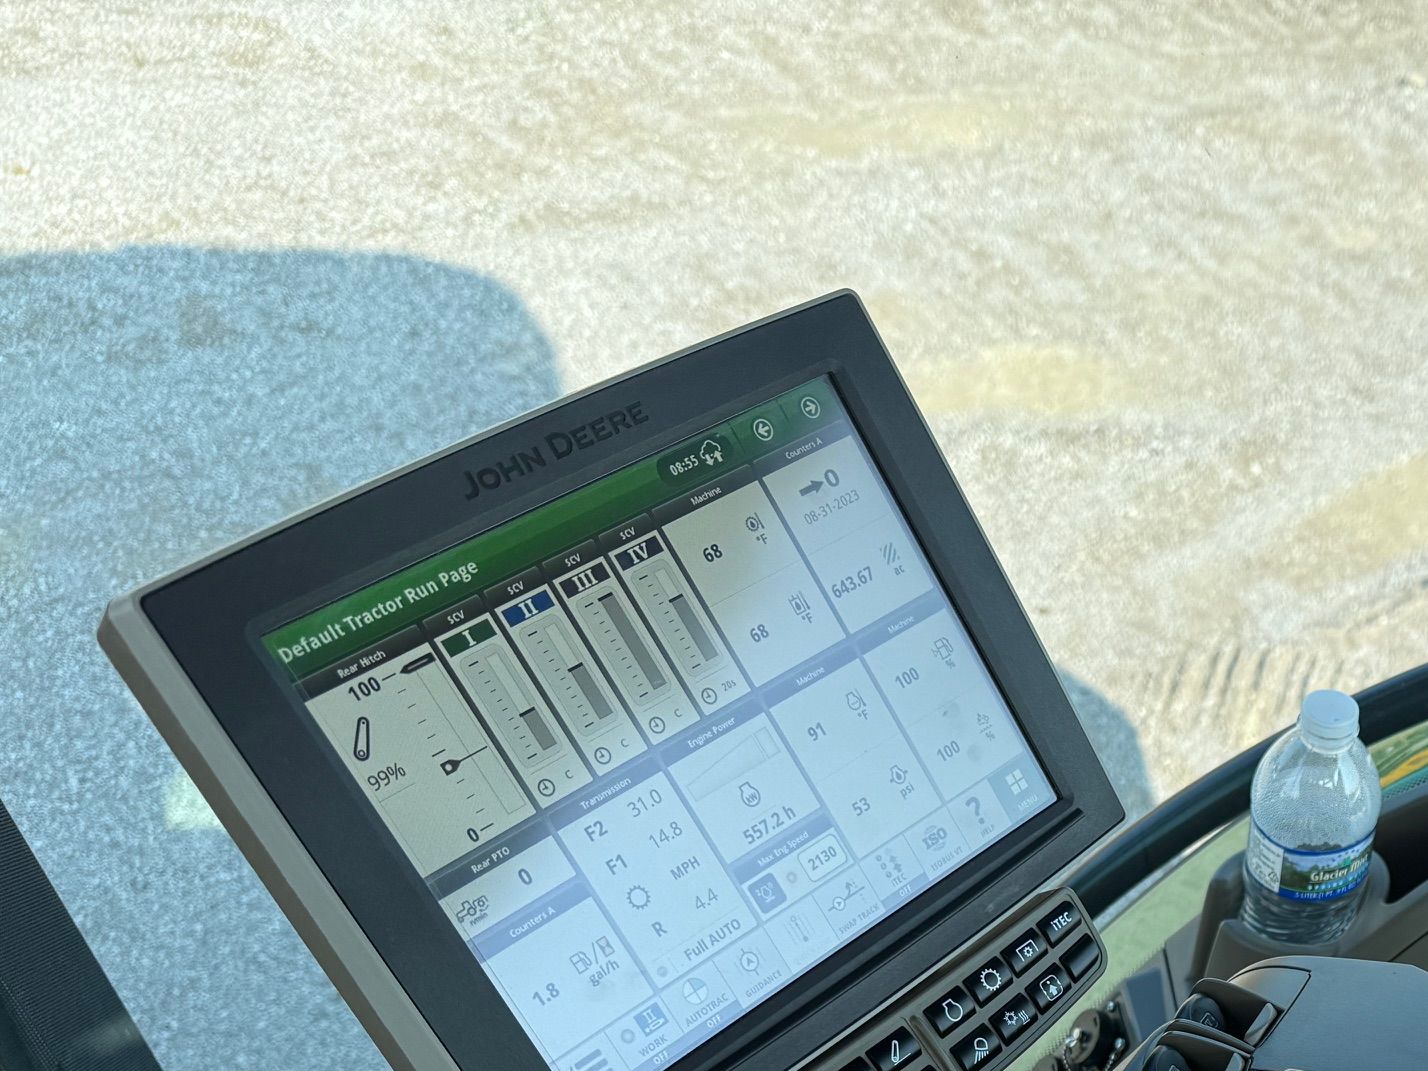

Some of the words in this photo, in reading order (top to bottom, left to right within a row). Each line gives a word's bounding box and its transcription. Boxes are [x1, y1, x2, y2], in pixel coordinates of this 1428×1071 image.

[463, 445, 547, 501] JOHN
[543, 400, 649, 460] DEERE
[784, 441, 815, 459] Counters
[815, 437, 822, 445] A
[669, 454, 698, 475] 08:55
[690, 486, 721, 505] Machine
[803, 489, 860, 524] 08-31-2023
[619, 526, 635, 540] SCV
[564, 552, 580, 567] SCV
[627, 542, 647, 563] IV
[702, 543, 722, 562] 68
[506, 580, 523, 595] SCV
[571, 568, 597, 591] III
[831, 565, 872, 598] 643.67
[277, 623, 345, 663] Default
[342, 595, 403, 630] Tractor
[403, 580, 439, 603] Run
[437, 561, 478, 587] Page
[446, 609, 464, 624] SCV
[517, 598, 538, 618] II
[749, 623, 769, 642] 68
[887, 615, 914, 633] Machine
[336, 663, 358, 678] Rear
[358, 650, 386, 667] Hitch
[796, 666, 824, 685] Machine
[347, 676, 381, 701] 100
[720, 679, 736, 691] 20s
[894, 666, 919, 688] 100
[687, 730, 713, 748] Engine
[711, 717, 735, 734] Power
[807, 721, 826, 741] 91
[936, 740, 960, 761] 100
[366, 762, 406, 791] 99%
[580, 777, 631, 809] Transmission
[899, 782, 914, 800] psi
[583, 820, 608, 842] F2
[626, 788, 662, 817] 31.0
[851, 796, 870, 816] 53
[466, 827, 479, 842] 0
[742, 811, 784, 844] 557.2
[781, 805, 796, 820] h
[605, 853, 627, 875] F1
[648, 820, 682, 848] 14.8
[757, 854, 774, 866] Max
[773, 844, 789, 856] Eng
[786, 830, 809, 848] Speed
[921, 826, 947, 850] ISO
[470, 858, 490, 873] Rear
[490, 846, 509, 861] PTO
[669, 855, 700, 880] MPH
[807, 845, 837, 871] 2130
[517, 868, 532, 885] 0
[1310, 868, 1348, 882] Glacier
[509, 912, 546, 937] Counters
[547, 906, 556, 915] A
[651, 921, 667, 937] R
[695, 887, 718, 909] 4.4
[1050, 911, 1072, 931] iTEC
[683, 938, 709, 961] Full
[708, 918, 741, 946] AUTO
[588, 959, 619, 987] gal/h
[744, 969, 782, 997] GUIDANCE
[531, 982, 559, 1006] 1.8
[685, 992, 728, 1027] AUTOTRAC
[706, 1013, 721, 1028] OFF
[638, 1033, 668, 1056] WORK
[652, 1050, 668, 1064] OFF
